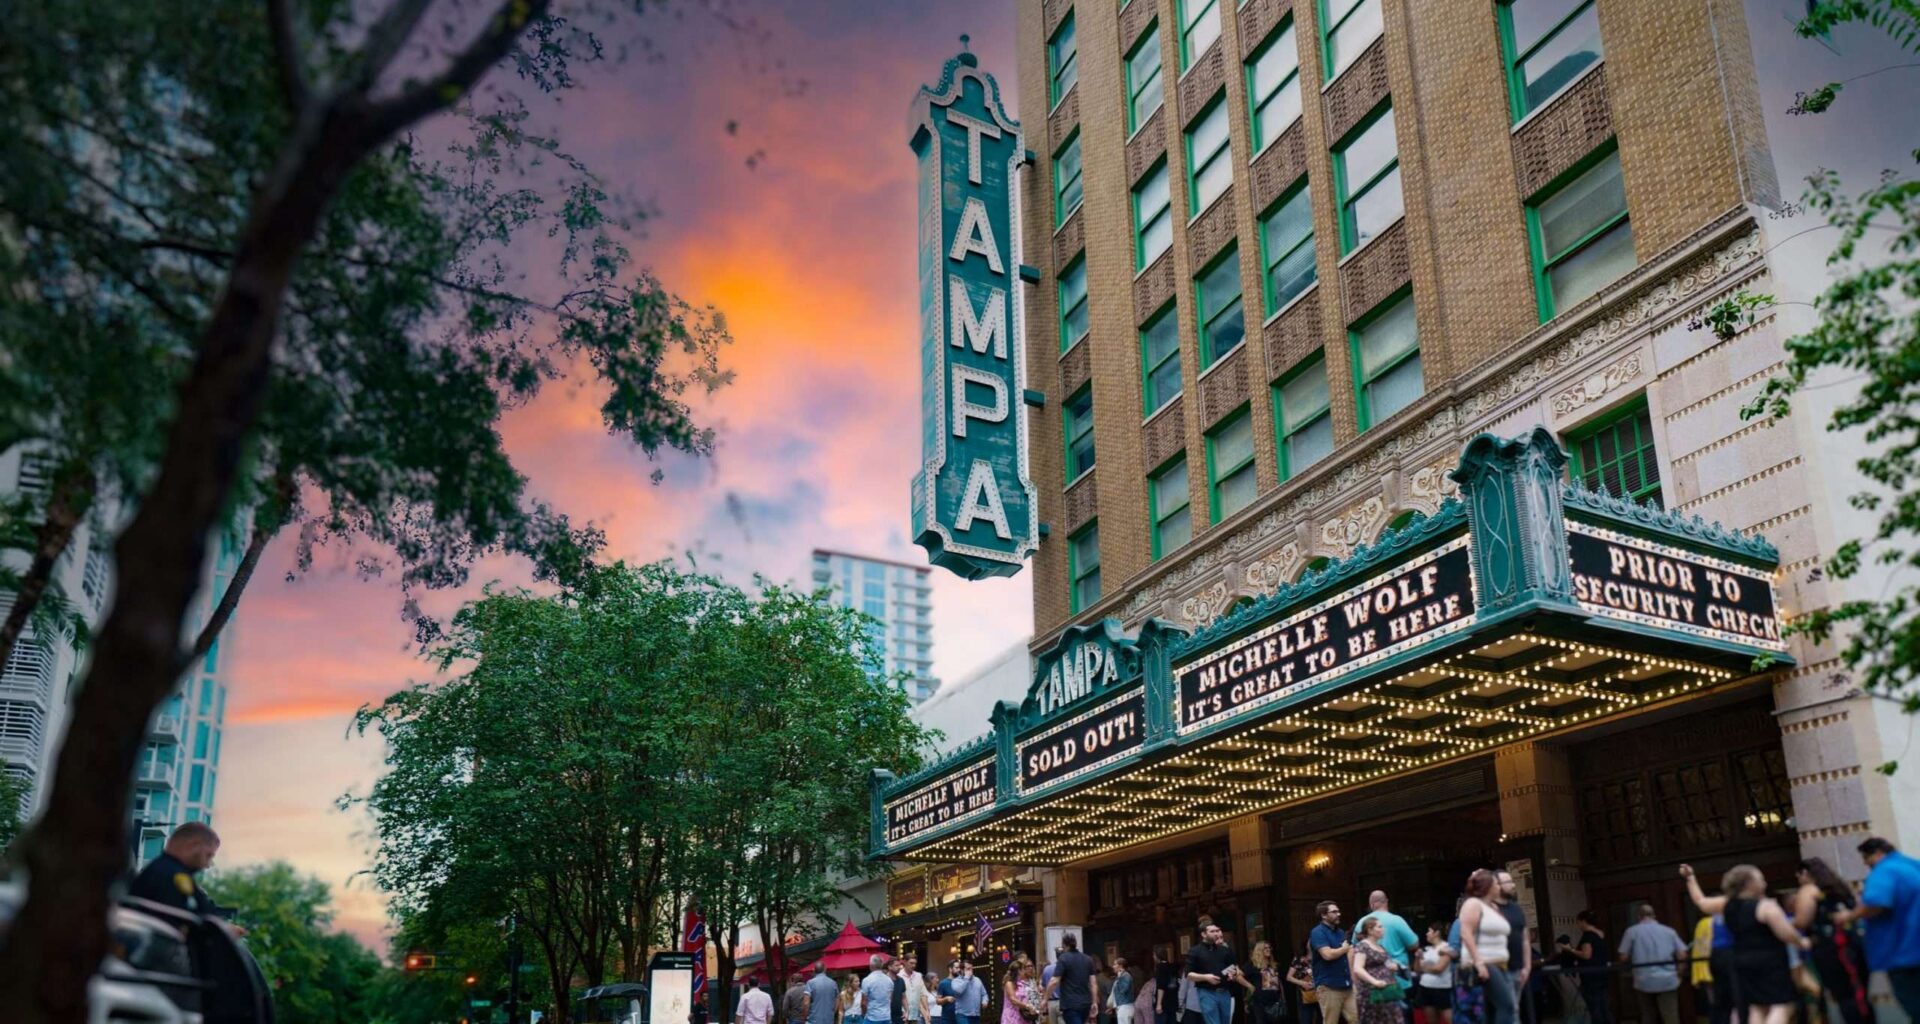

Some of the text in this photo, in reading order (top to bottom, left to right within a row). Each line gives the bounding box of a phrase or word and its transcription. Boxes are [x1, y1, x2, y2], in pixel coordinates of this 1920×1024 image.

[946, 107, 1012, 539] TAMPA
[1574, 573, 1779, 641] SECURITY CHECK
[1608, 545, 1741, 602] PRIOR TO
[1188, 594, 1461, 722] IT'S GREAT TO BE HERE
[1199, 565, 1438, 693] MICHELLE WOLF
[1035, 641, 1118, 716] TAMPA
[1029, 711, 1135, 777] SOLD OUT!
[891, 788, 994, 840] IT'S GREAT TO BE HERE
[896, 768, 988, 822] MICHELLE WOLF
